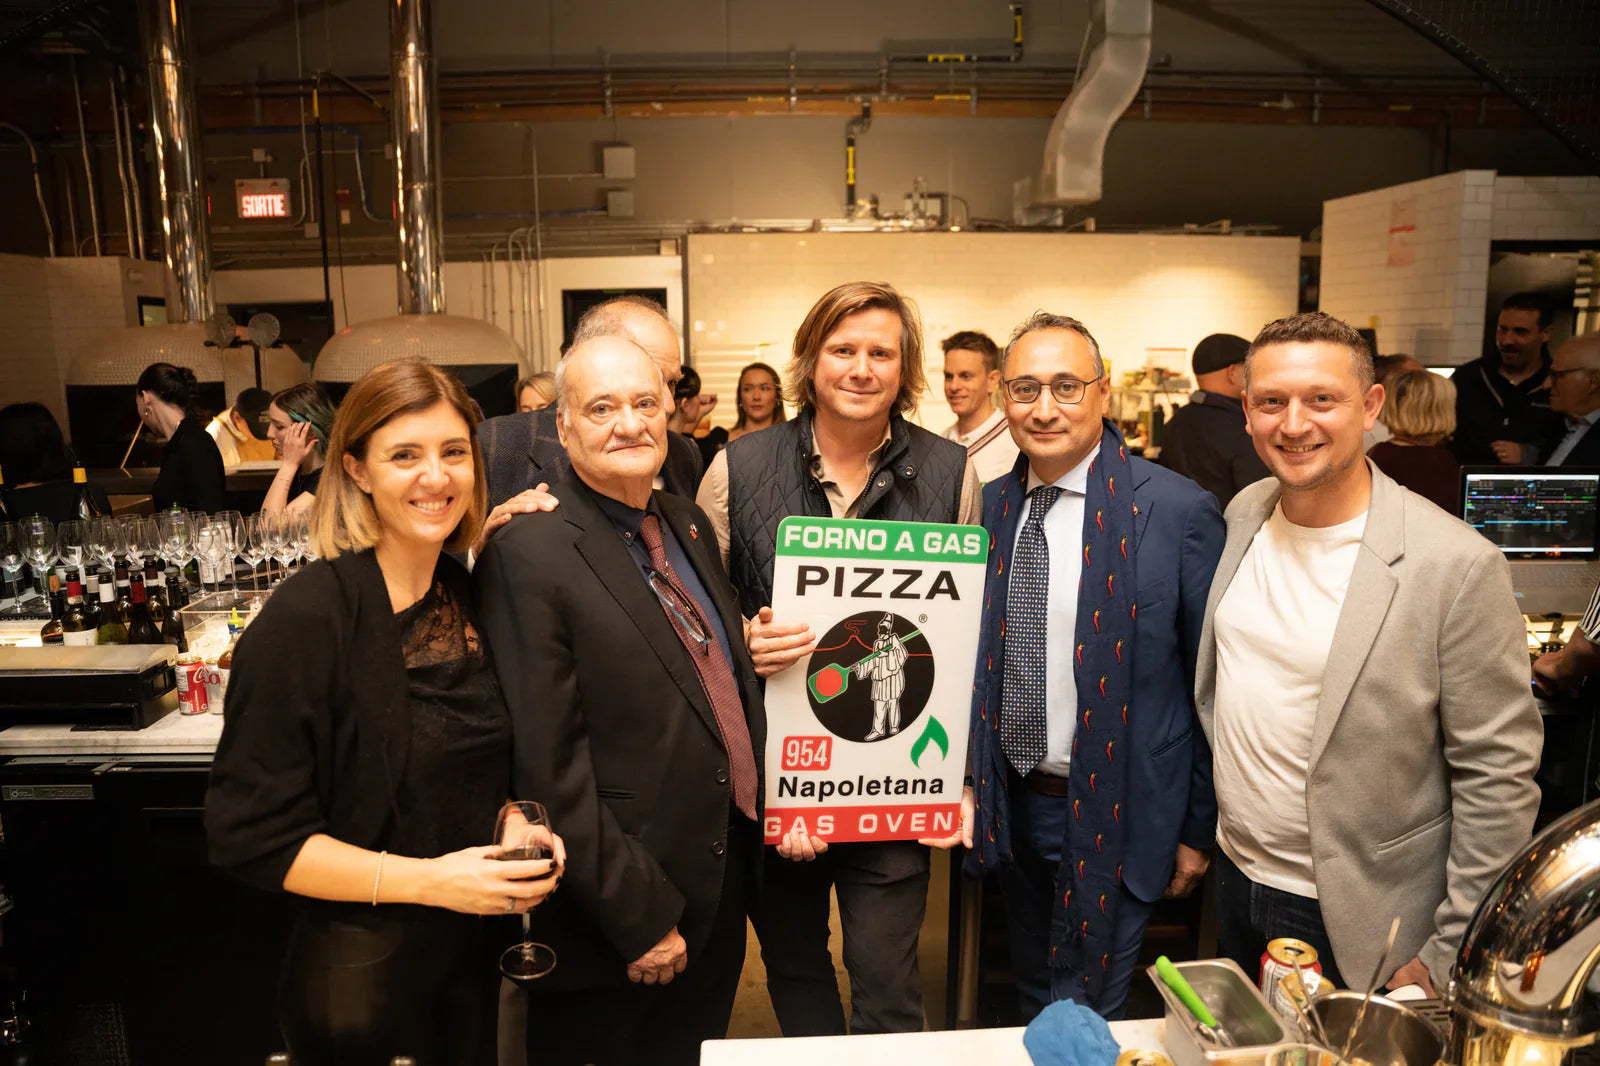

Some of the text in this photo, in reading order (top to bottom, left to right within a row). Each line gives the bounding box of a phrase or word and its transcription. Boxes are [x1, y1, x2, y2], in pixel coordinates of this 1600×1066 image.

[242, 194, 286, 217] SORTIE
[784, 525, 981, 555] FORNO A GAS
[796, 565, 961, 600] PIZZA
[786, 739, 828, 767] 954
[778, 775, 944, 802] Napoletana
[764, 811, 953, 837] GAS OVEN
